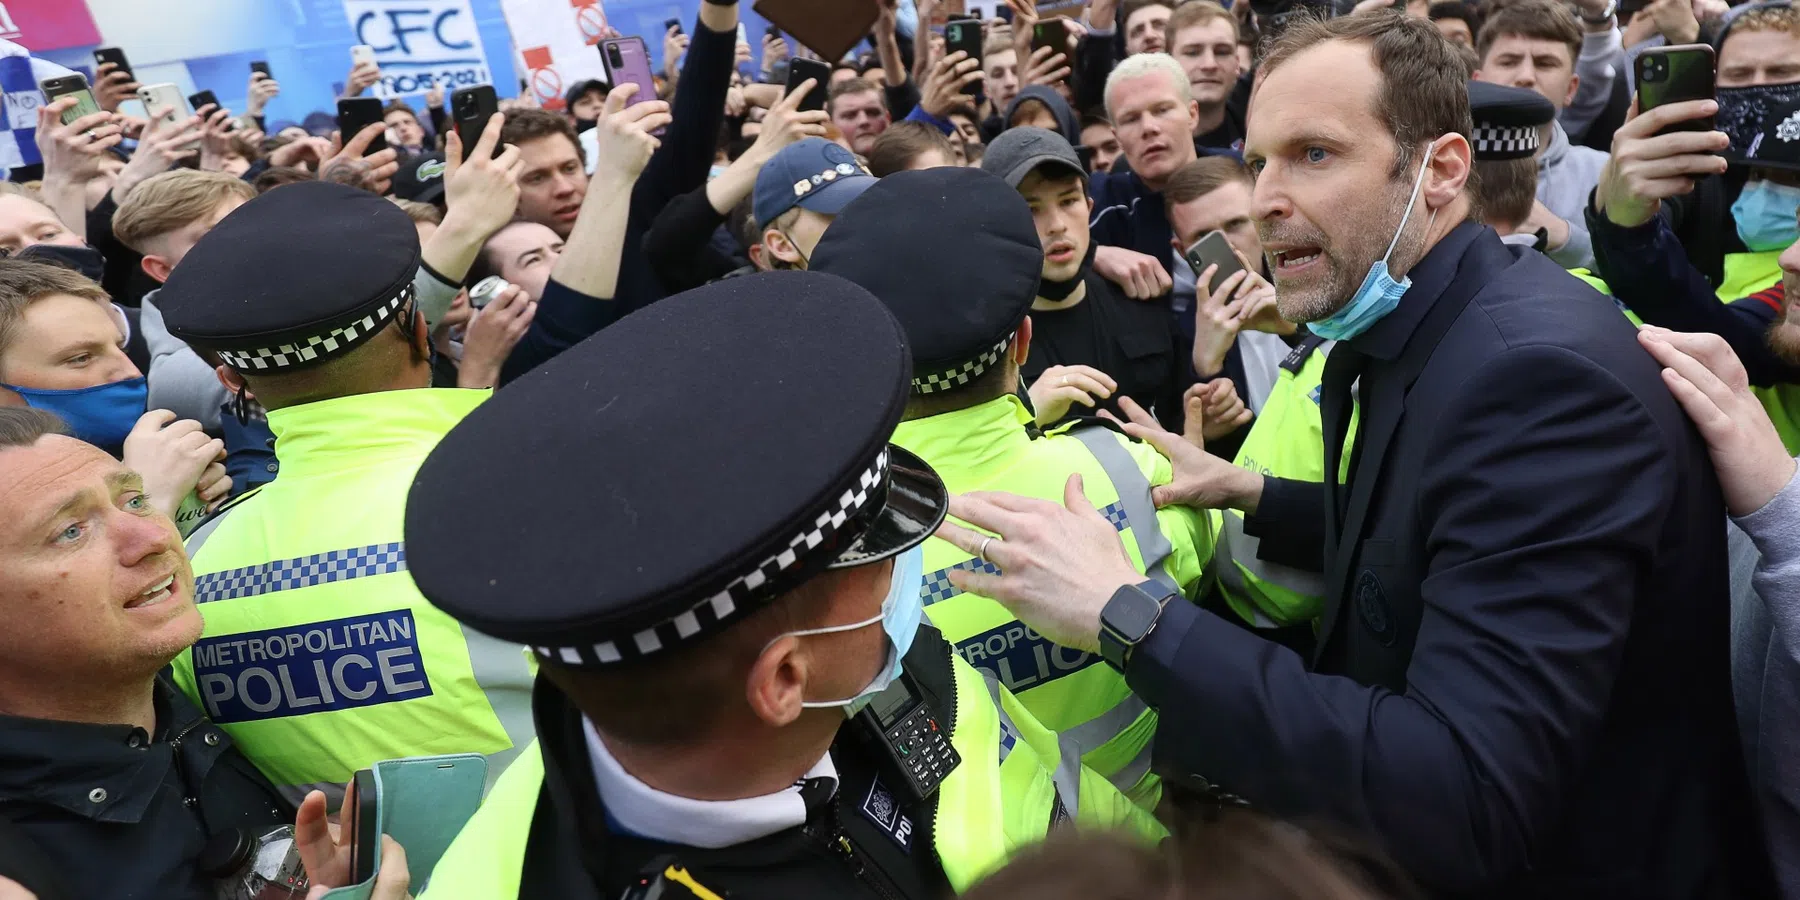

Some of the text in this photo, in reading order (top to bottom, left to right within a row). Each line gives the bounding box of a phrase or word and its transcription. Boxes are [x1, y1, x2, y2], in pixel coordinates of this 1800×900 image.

[356, 9, 473, 54] CFC
[196, 616, 412, 668] METROPOLITAN
[200, 646, 425, 717] POLICE
